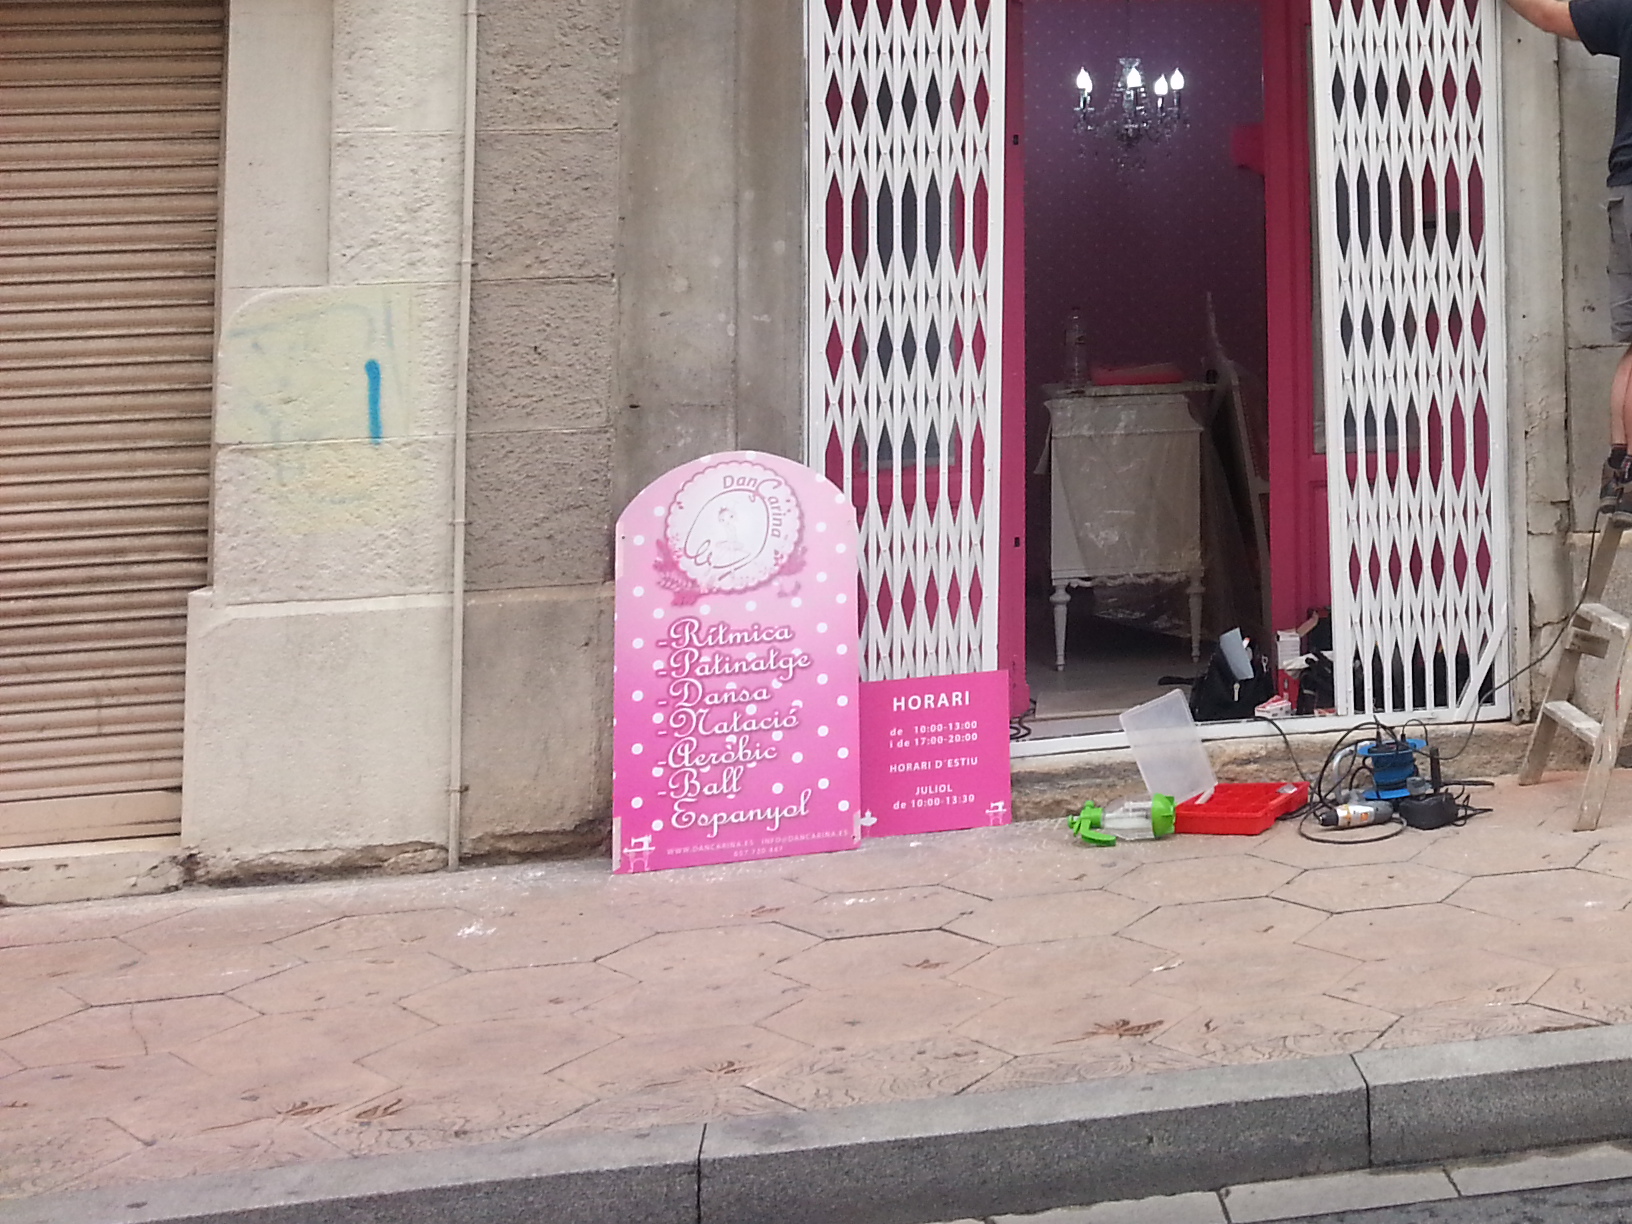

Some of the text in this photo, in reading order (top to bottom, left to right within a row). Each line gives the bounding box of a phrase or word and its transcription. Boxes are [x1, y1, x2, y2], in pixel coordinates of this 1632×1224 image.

[892, 690, 971, 712] HORARI
[889, 720, 978, 737] de 10:00-13:00
[897, 739, 910, 748] de
[914, 732, 978, 746] 17:00-20:00
[889, 760, 932, 773] HORARI
[915, 783, 953, 796] JULIOL
[670, 788, 812, 838] Espanyol
[893, 800, 907, 810] de
